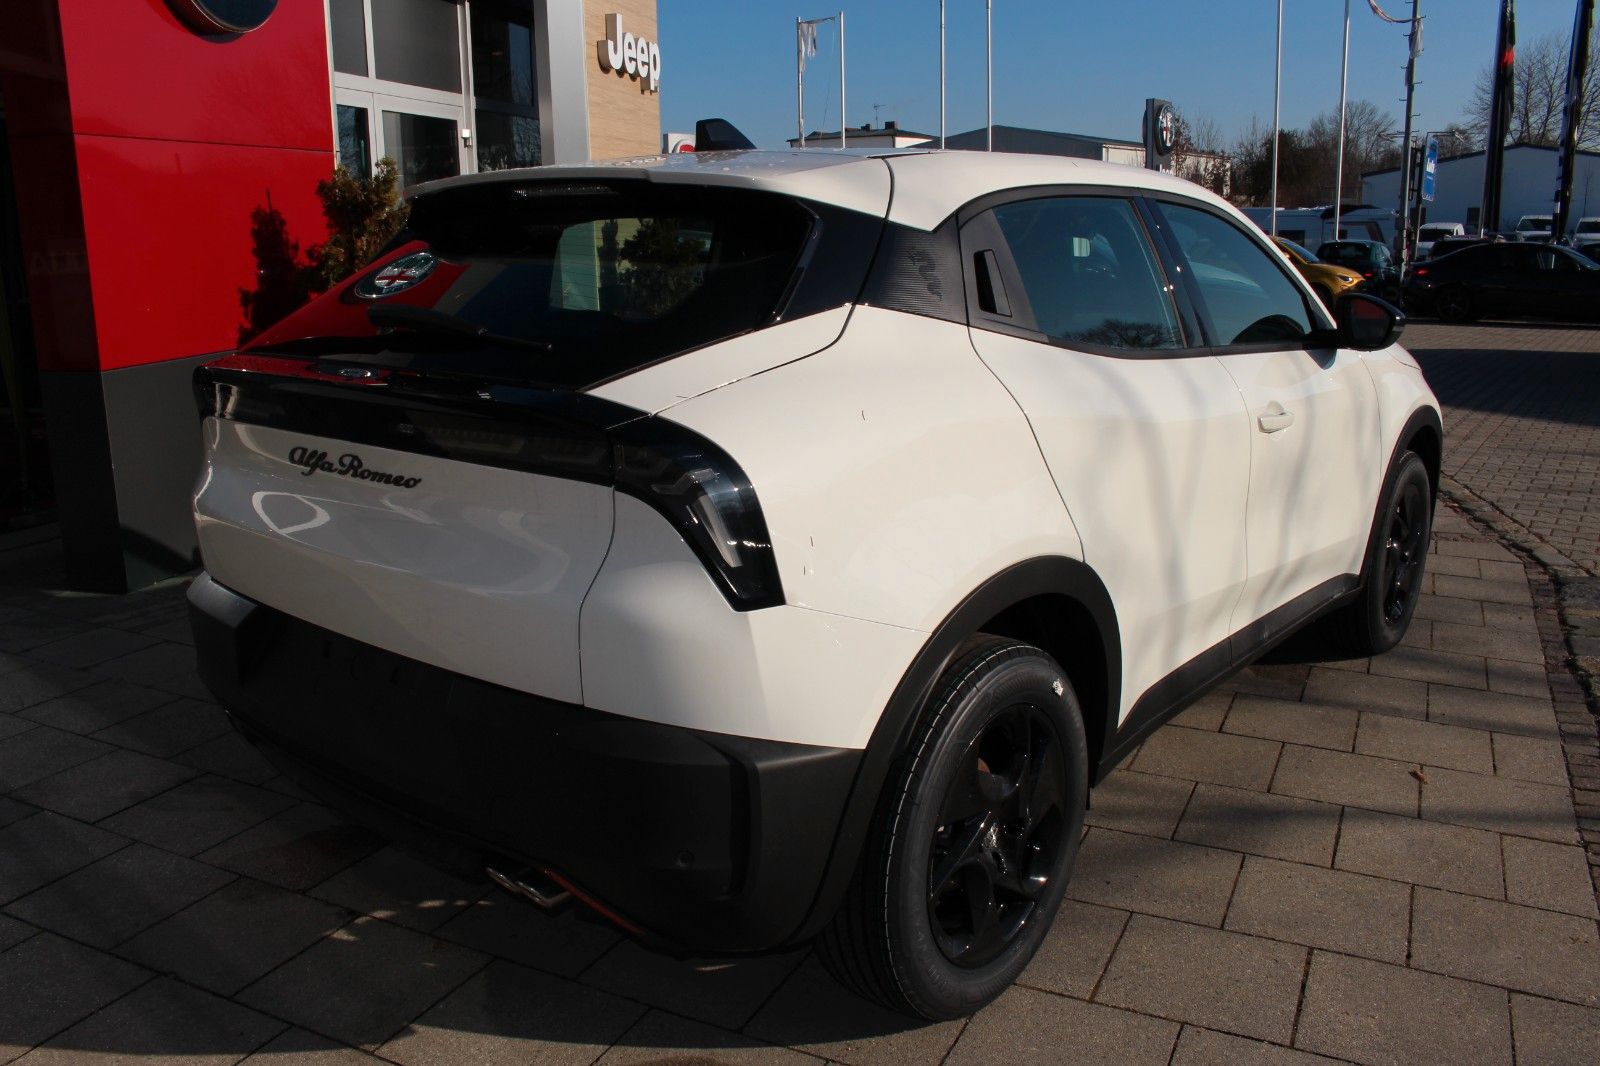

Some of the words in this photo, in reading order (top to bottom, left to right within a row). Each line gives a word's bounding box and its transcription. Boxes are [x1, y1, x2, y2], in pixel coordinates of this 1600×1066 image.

[604, 13, 661, 91] Jeep
[288, 446, 338, 476] Alfa
[338, 453, 422, 489] Romeo
